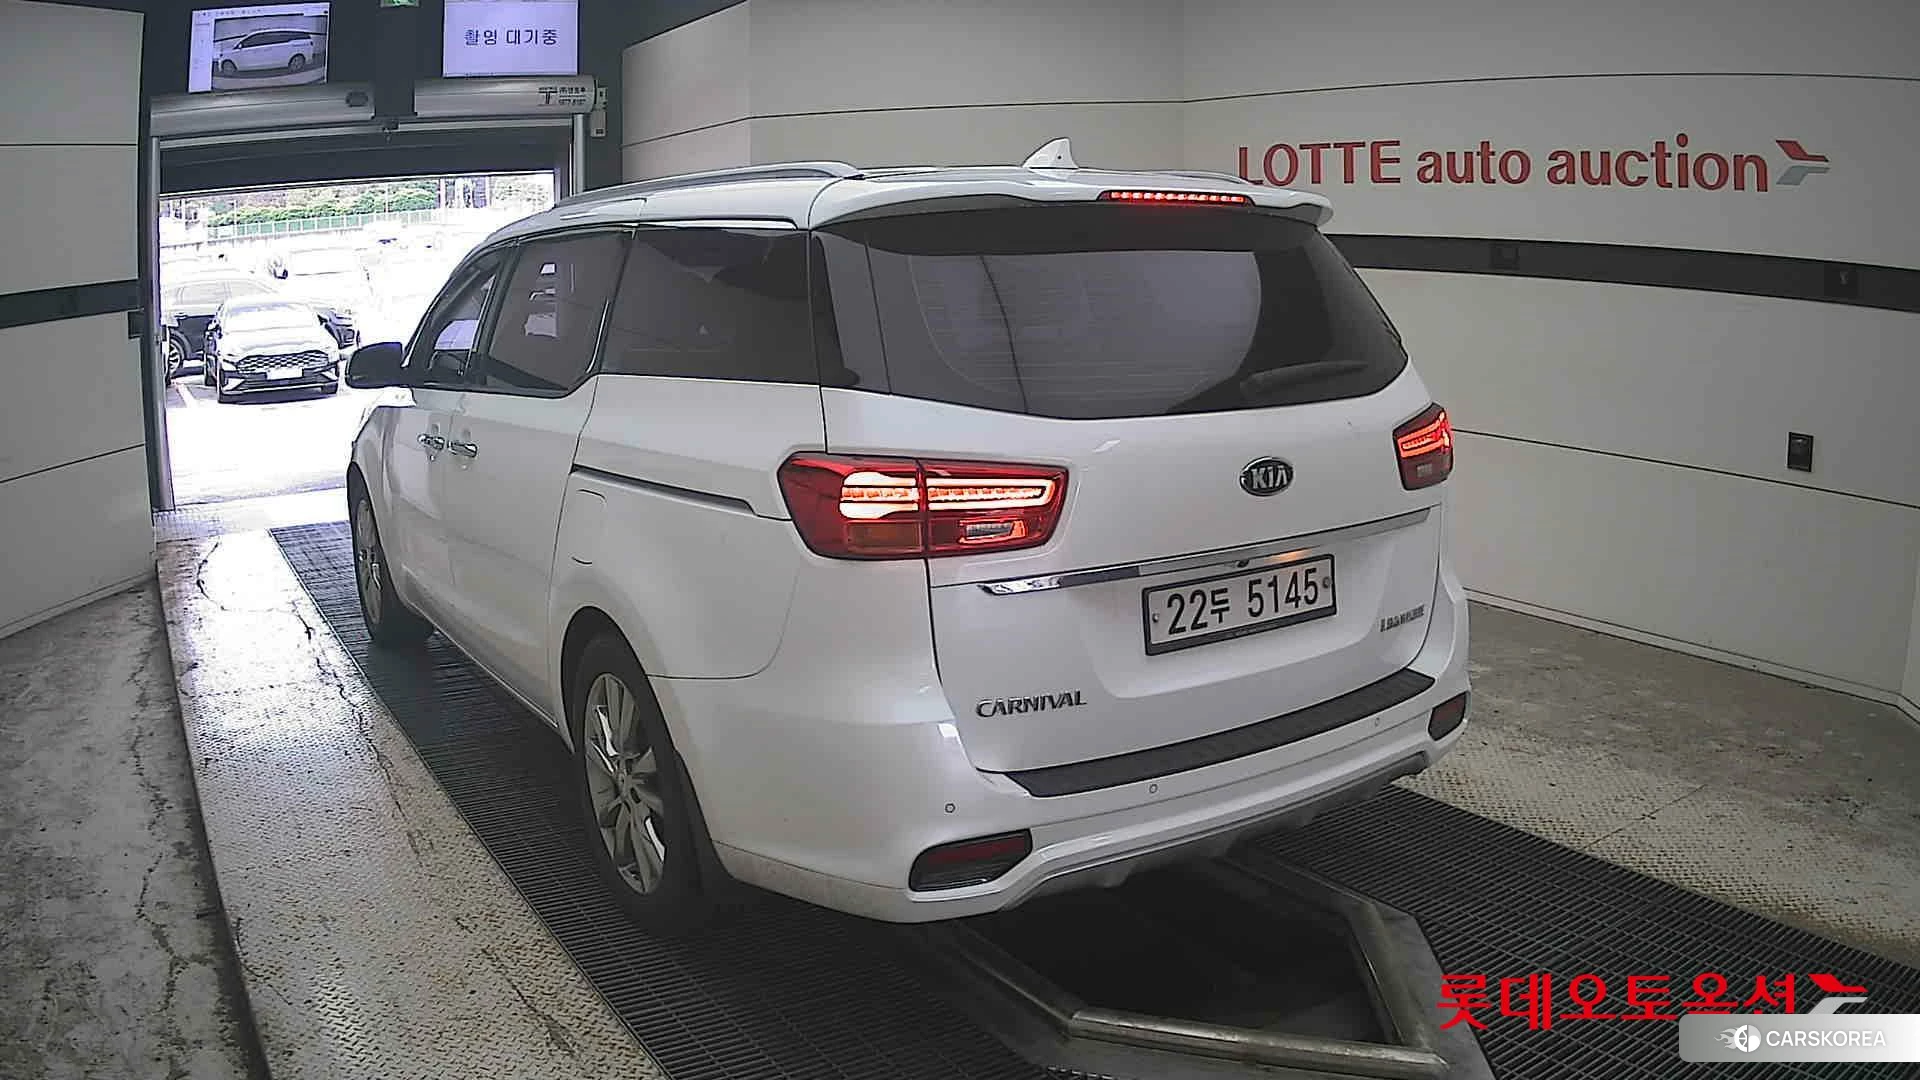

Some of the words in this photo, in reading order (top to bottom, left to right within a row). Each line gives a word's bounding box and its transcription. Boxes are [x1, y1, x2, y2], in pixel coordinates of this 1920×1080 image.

[506, 29, 559, 46] 대기중
[1238, 139, 1400, 186] LOTTE
[1417, 140, 1531, 185] auto
[1547, 134, 1769, 193] auction
[1250, 464, 1289, 490] KIA
[1167, 588, 1230, 635] 22두
[1248, 567, 1319, 618] 5145
[976, 690, 1088, 718] CARNIVAL
